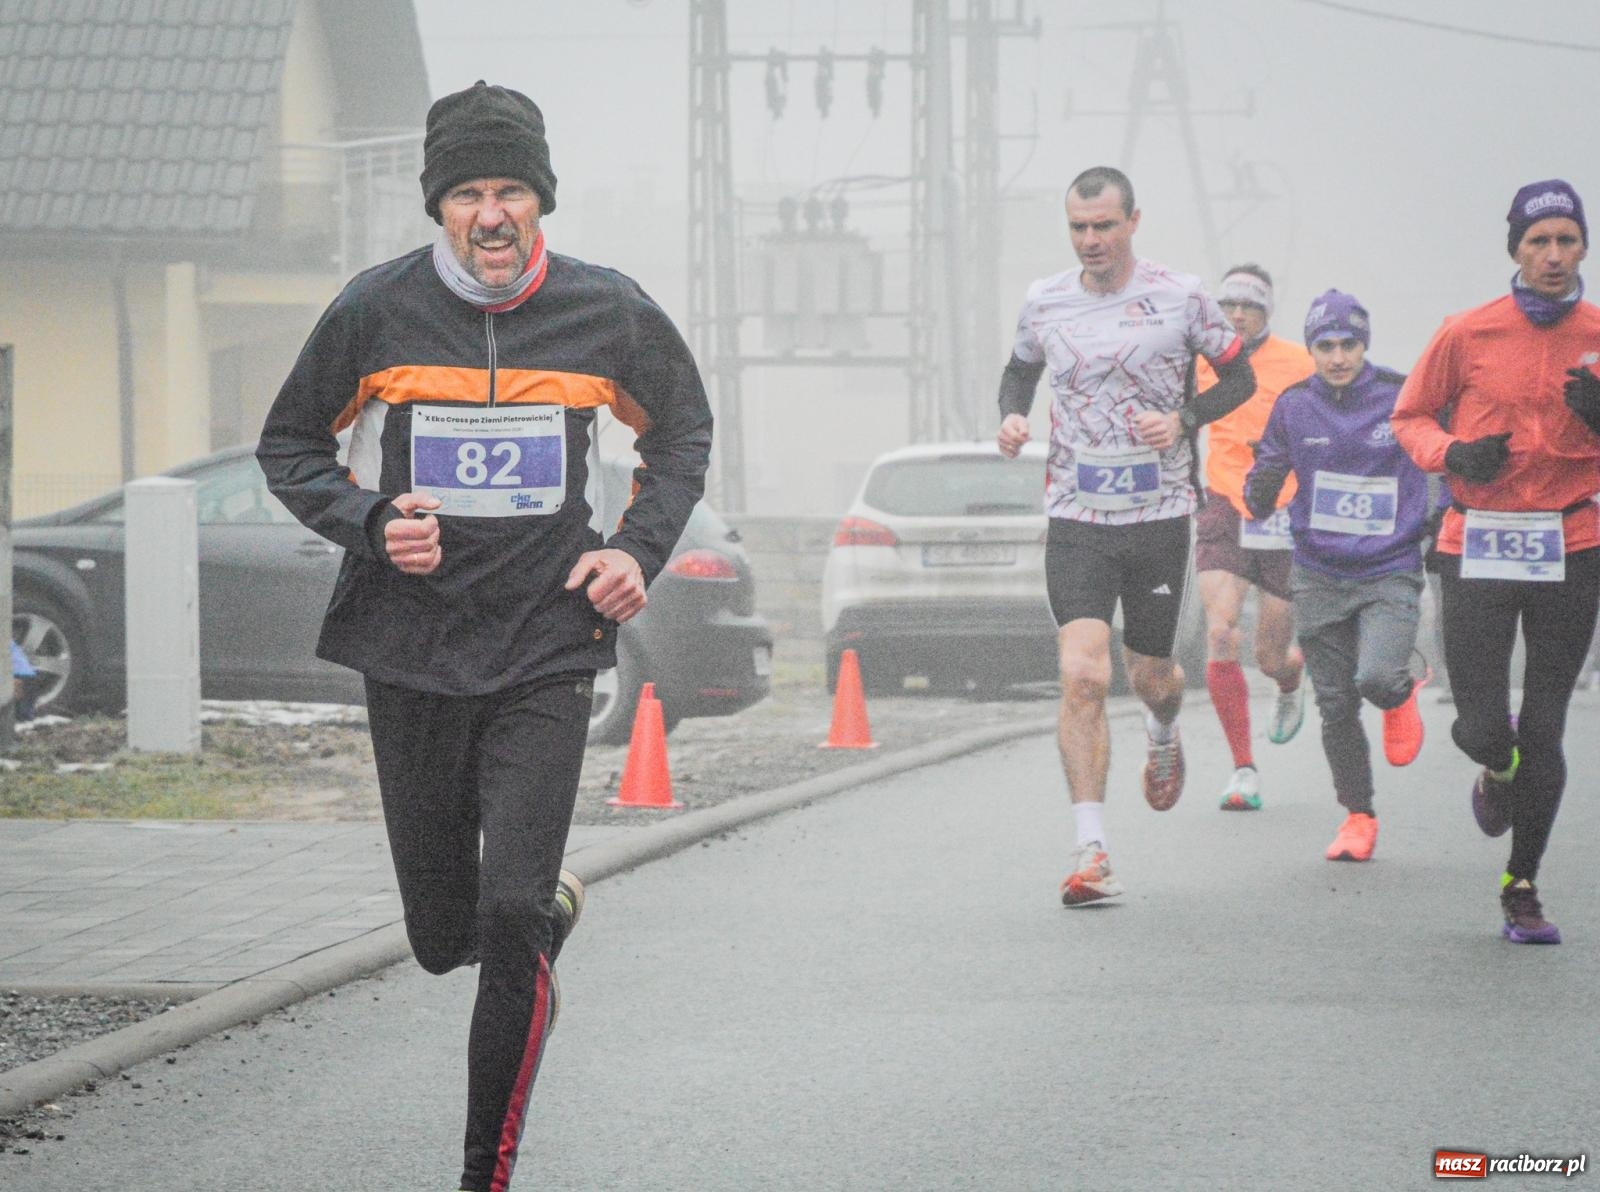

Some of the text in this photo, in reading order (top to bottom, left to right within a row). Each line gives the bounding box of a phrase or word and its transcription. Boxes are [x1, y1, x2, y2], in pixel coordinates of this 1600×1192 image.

[446, 416, 468, 424] Cross
[469, 417, 480, 425] po
[480, 416, 502, 424] Ziemi
[503, 414, 553, 423] Pietrowickiej
[455, 441, 522, 486] 82
[1096, 466, 1136, 493] 24
[1336, 493, 1372, 519] 68
[1482, 531, 1545, 560] 135
